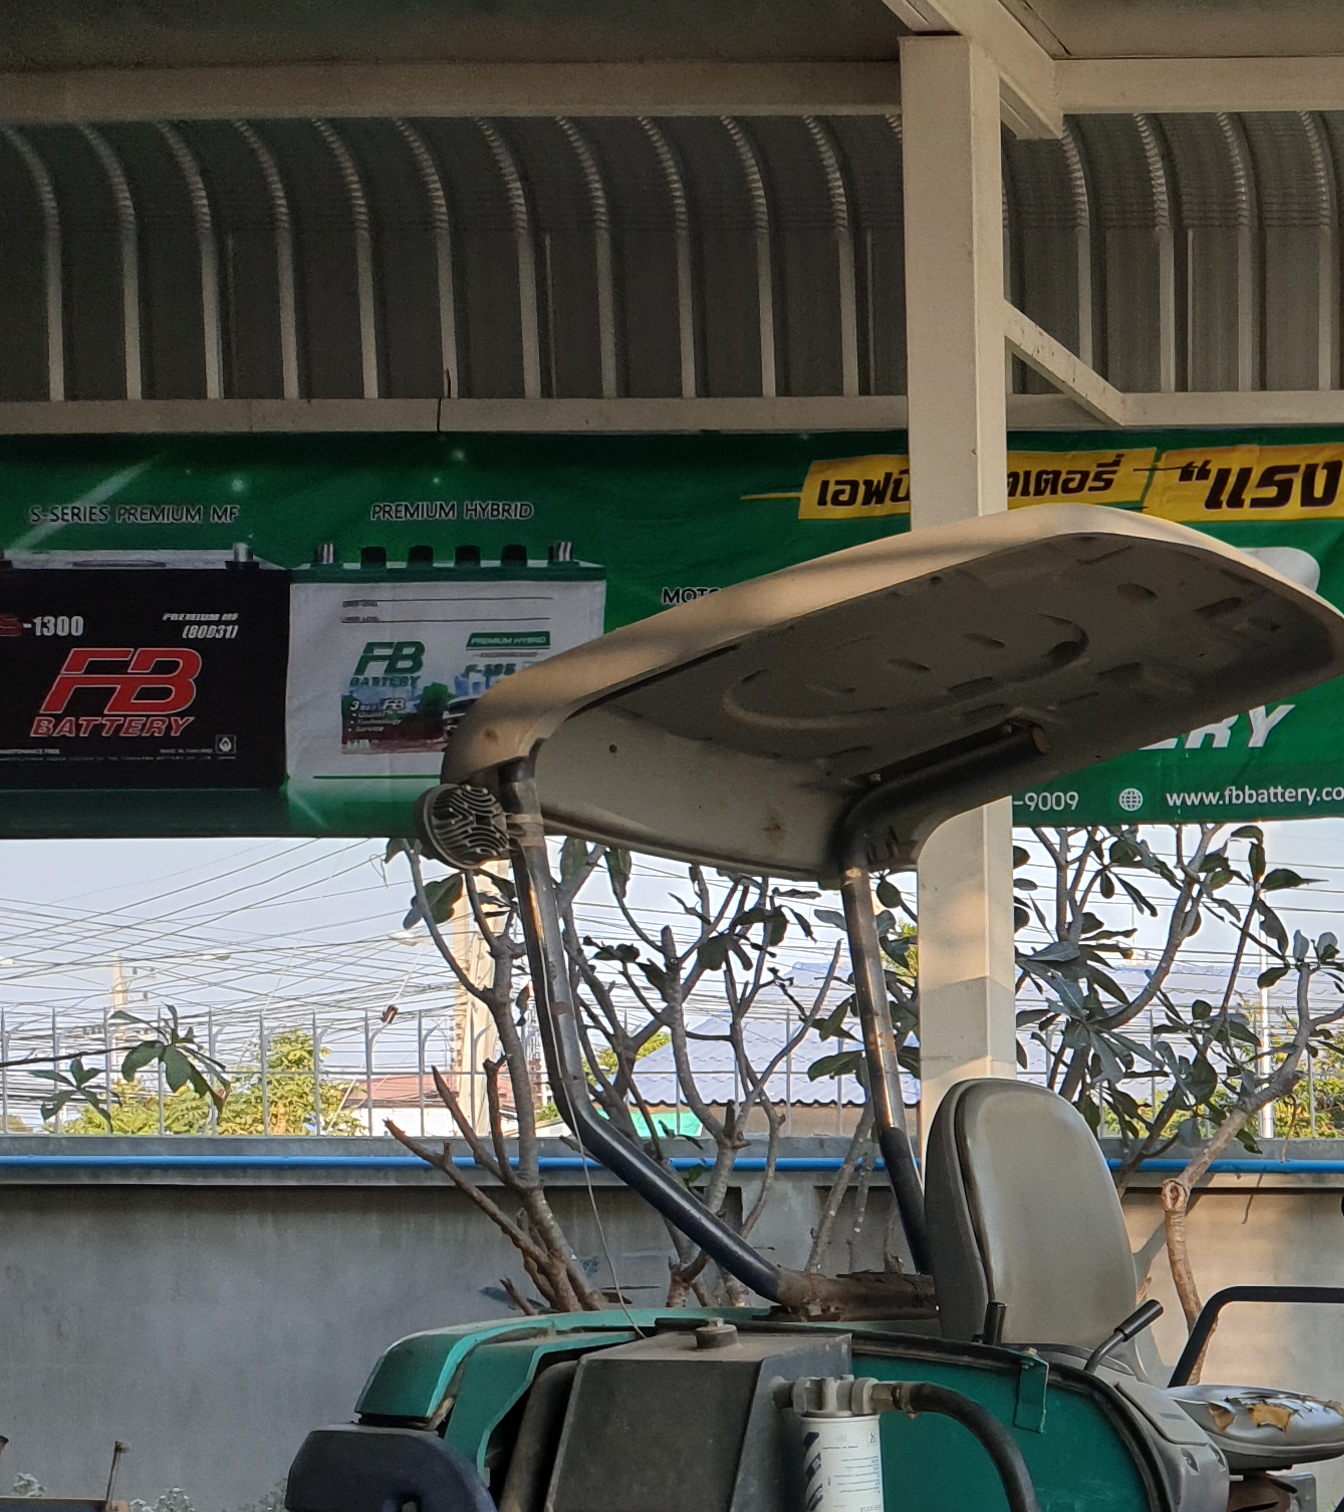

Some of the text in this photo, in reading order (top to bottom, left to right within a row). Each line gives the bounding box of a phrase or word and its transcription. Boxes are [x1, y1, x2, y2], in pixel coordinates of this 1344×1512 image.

[29, 504, 241, 524] S-SERIES PREMIUM MF
[371, 501, 534, 521] PREMIUM HYBRID
[353, 640, 426, 676] FB
[39, 647, 203, 714] FB
[350, 675, 421, 689] BATTERY
[30, 717, 195, 738] BATTERY
